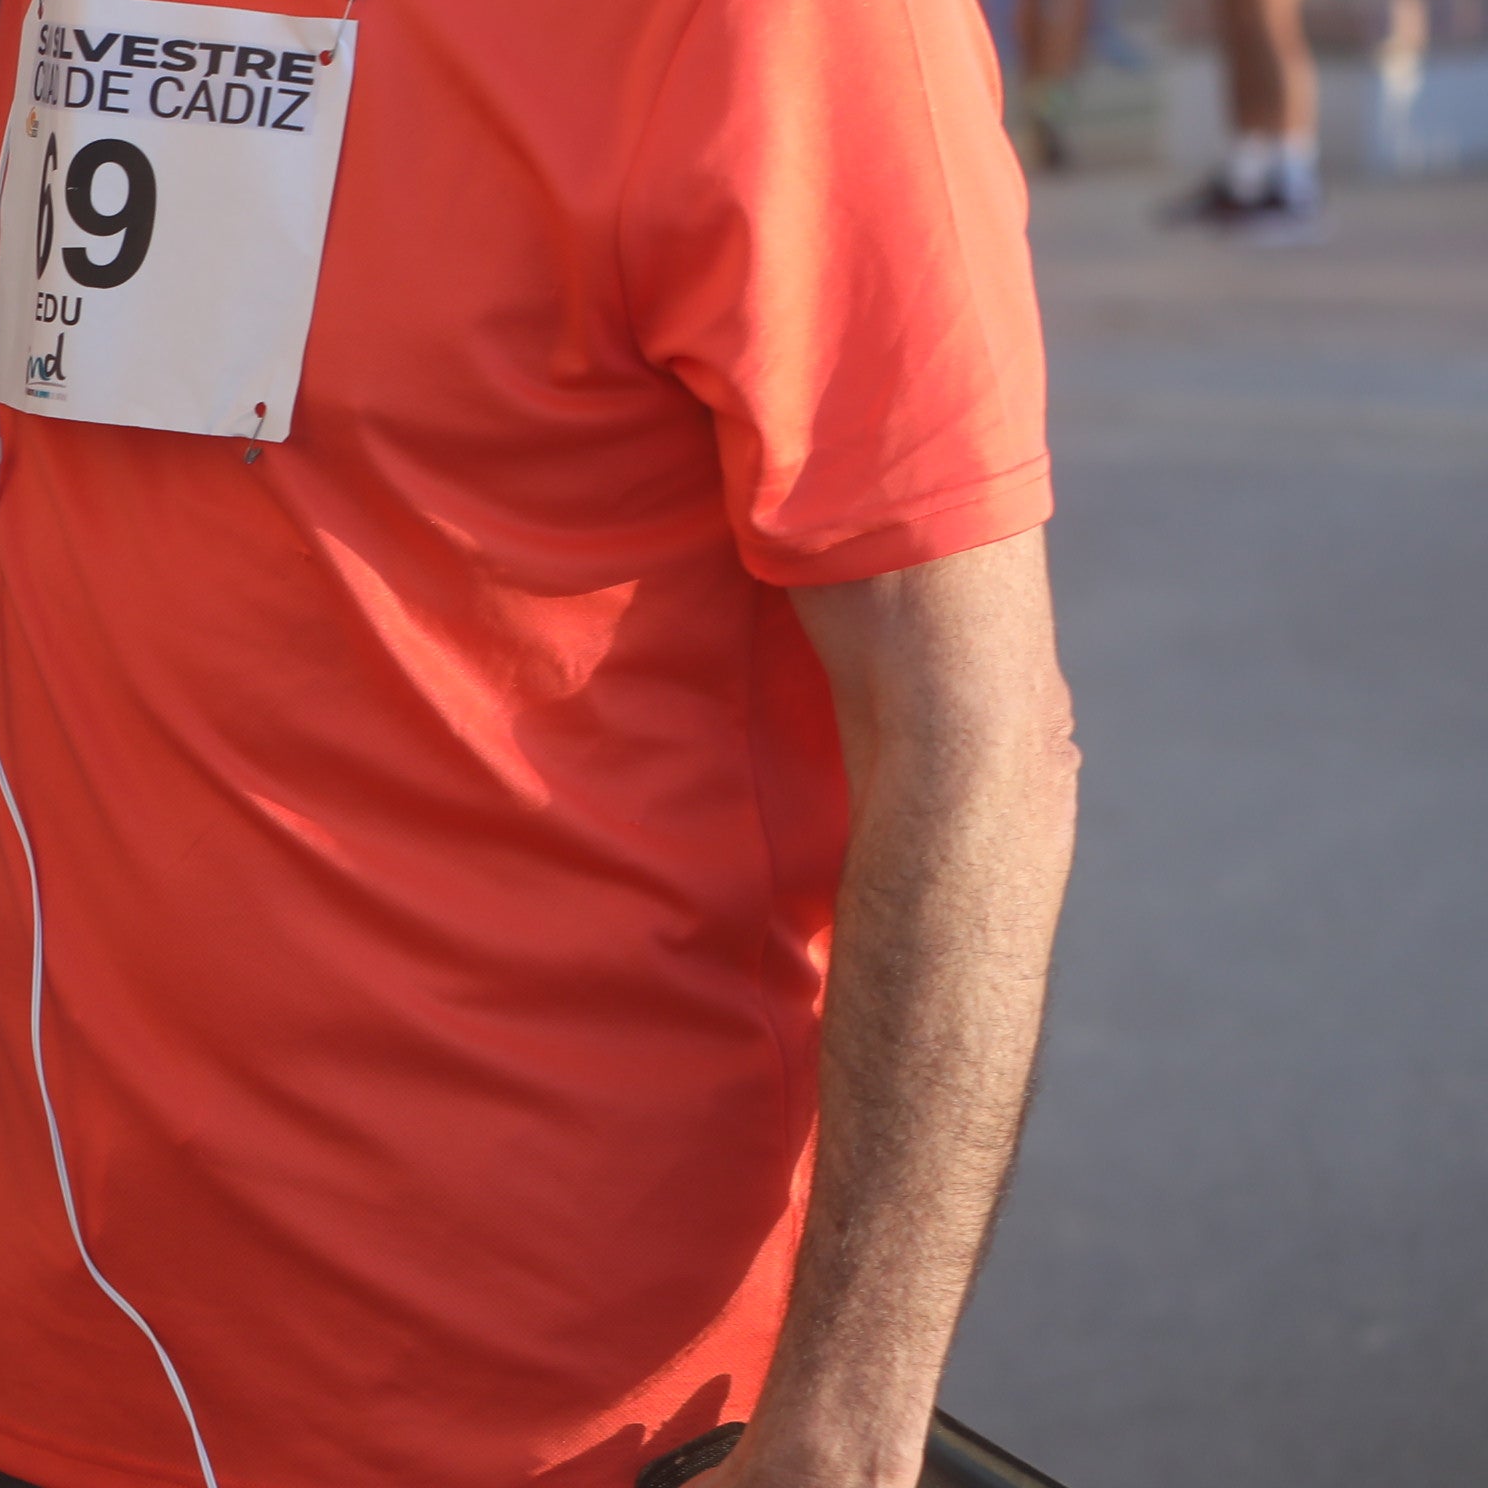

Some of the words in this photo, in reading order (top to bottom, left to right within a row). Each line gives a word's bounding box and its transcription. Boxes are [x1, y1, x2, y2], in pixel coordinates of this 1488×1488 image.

[64, 66, 133, 114] DE
[149, 73, 310, 132] CÁDIZ
[36, 132, 157, 289] 69
[35, 292, 82, 326] EDU
